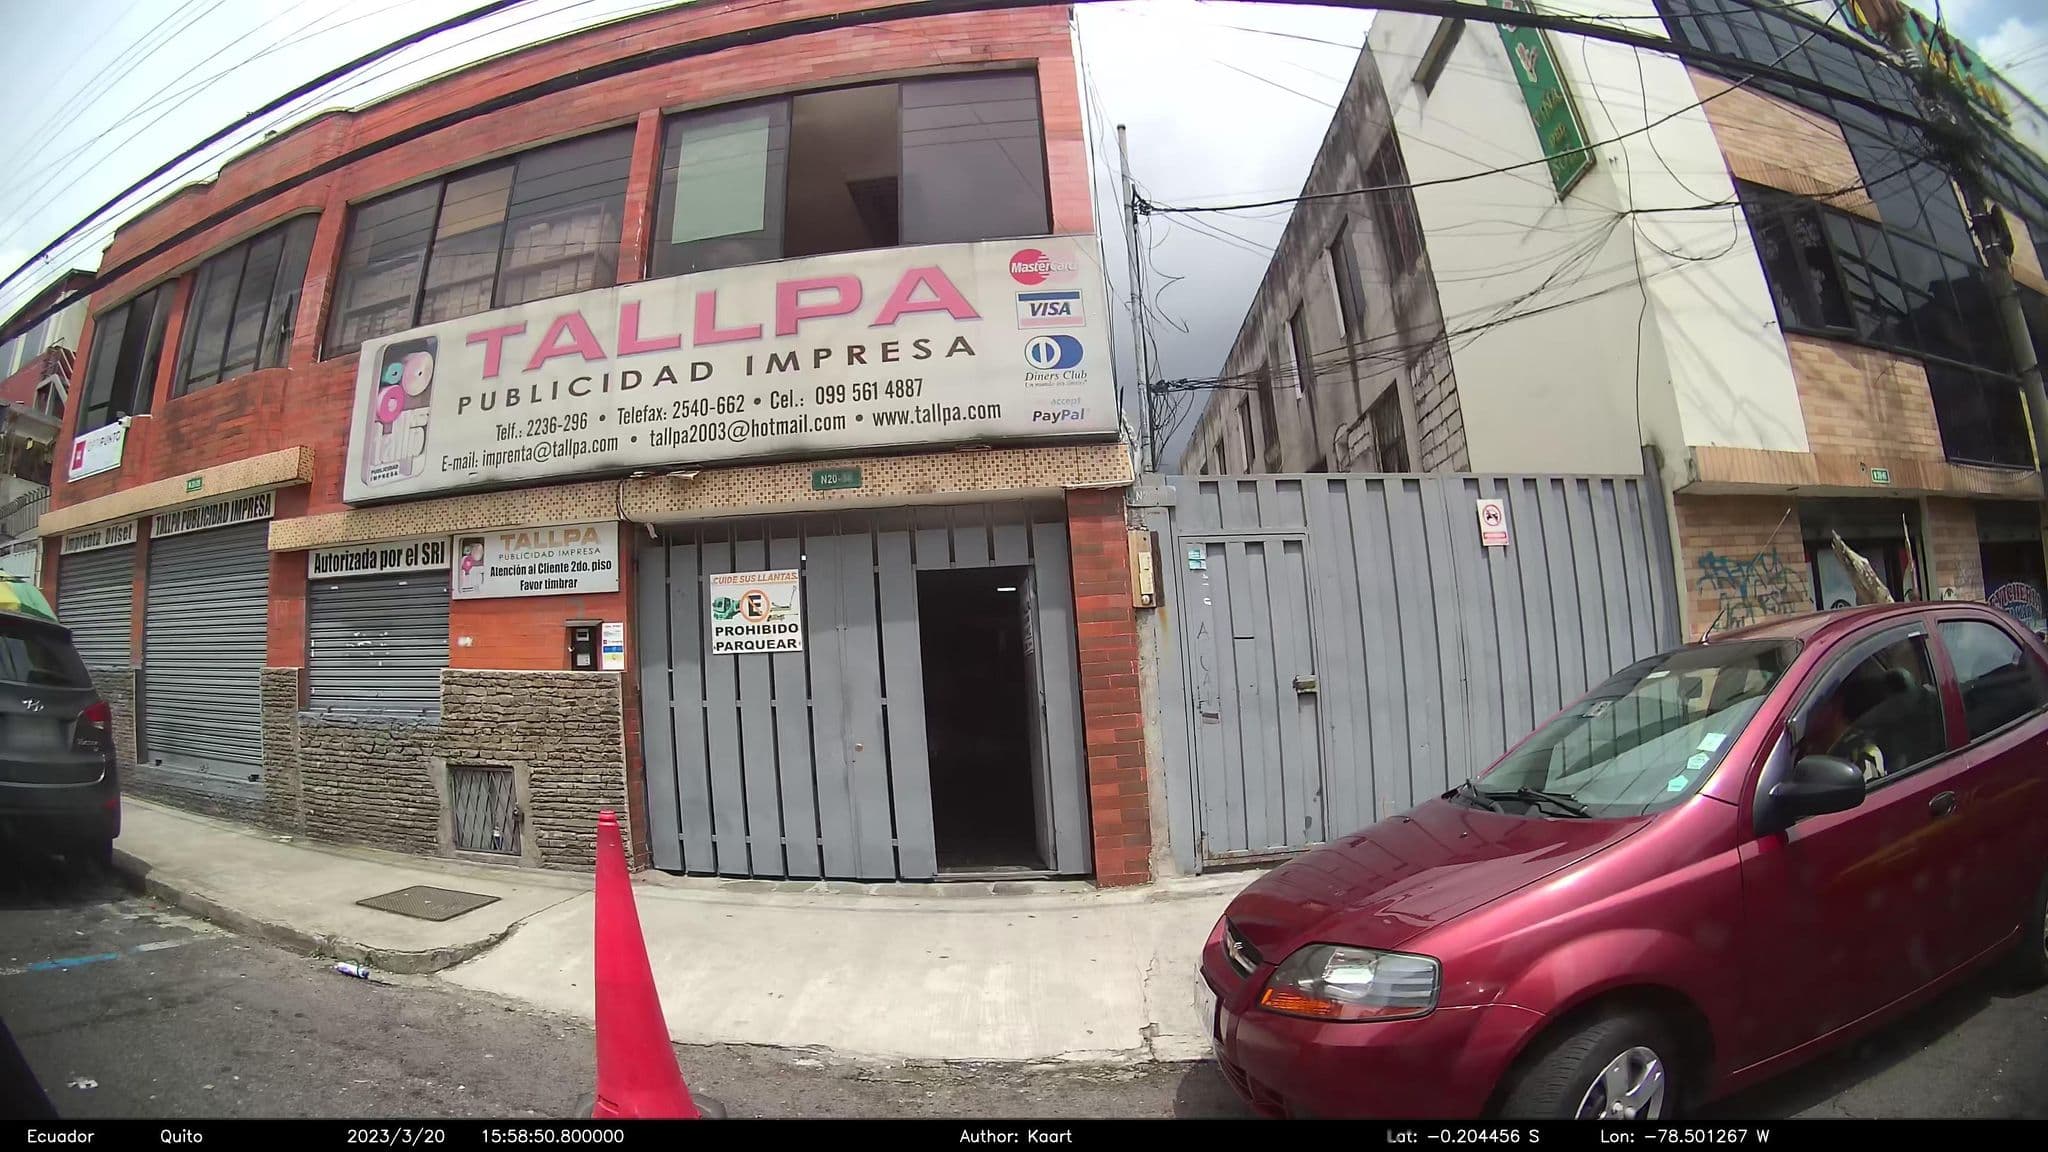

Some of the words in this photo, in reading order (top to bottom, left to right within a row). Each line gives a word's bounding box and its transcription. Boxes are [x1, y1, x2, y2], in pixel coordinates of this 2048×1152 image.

[1030, 301, 1071, 317] VISA
[466, 265, 984, 380] TALLPA
[457, 361, 714, 415] PUBLICIDAD
[746, 336, 976, 376] IMPRESA
[1025, 372, 1059, 382] Diners
[1063, 369, 1088, 380] Club
[496, 422, 523, 442] Telf.:
[526, 412, 588, 438] 2236-296
[618, 404, 667, 425] Telefax:
[672, 394, 745, 420] 2540-662
[770, 390, 804, 410] Cel.:
[816, 385, 846, 405] 099
[852, 382, 878, 402] 561
[885, 378, 923, 399] 4887
[1032, 408, 1085, 424] PayPal
[442, 452, 478, 472] E-mail:
[482, 435, 618, 467] imprenta@tallpa.com
[650, 414, 846, 448] tallpa2003@hotmail.com
[873, 403, 1001, 426] www.tallpa.com
[370, 472, 398, 481] IMPRESA
[371, 464, 399, 475] PUBLICIDAD
[156, 513, 180, 535] TALLPA
[181, 503, 229, 532] PUBLICIDAD
[229, 494, 272, 522] IMPRESA
[66, 531, 101, 548] Imprenta
[105, 524, 132, 544] Offset
[500, 527, 600, 553] TALLPA
[314, 548, 377, 574] Autorizada
[380, 549, 403, 571] por
[406, 543, 418, 566] el
[422, 541, 445, 565] SRI
[499, 550, 555, 561] PUBLICIDAD
[558, 547, 601, 557] IMPRESA
[490, 563, 527, 577] Atención
[528, 563, 536, 575] al
[538, 561, 569, 574] Cliente
[571, 560, 590, 572] 2do.
[592, 559, 612, 572] piso
[520, 579, 543, 591] Favor
[544, 578, 578, 590] timbrar
[713, 575, 739, 585] CUIDE
[739, 574, 756, 584] SUS
[757, 572, 798, 582] LLANTAS
[715, 623, 799, 637] PROHIBIDO
[716, 638, 798, 652] PARQUEAR
